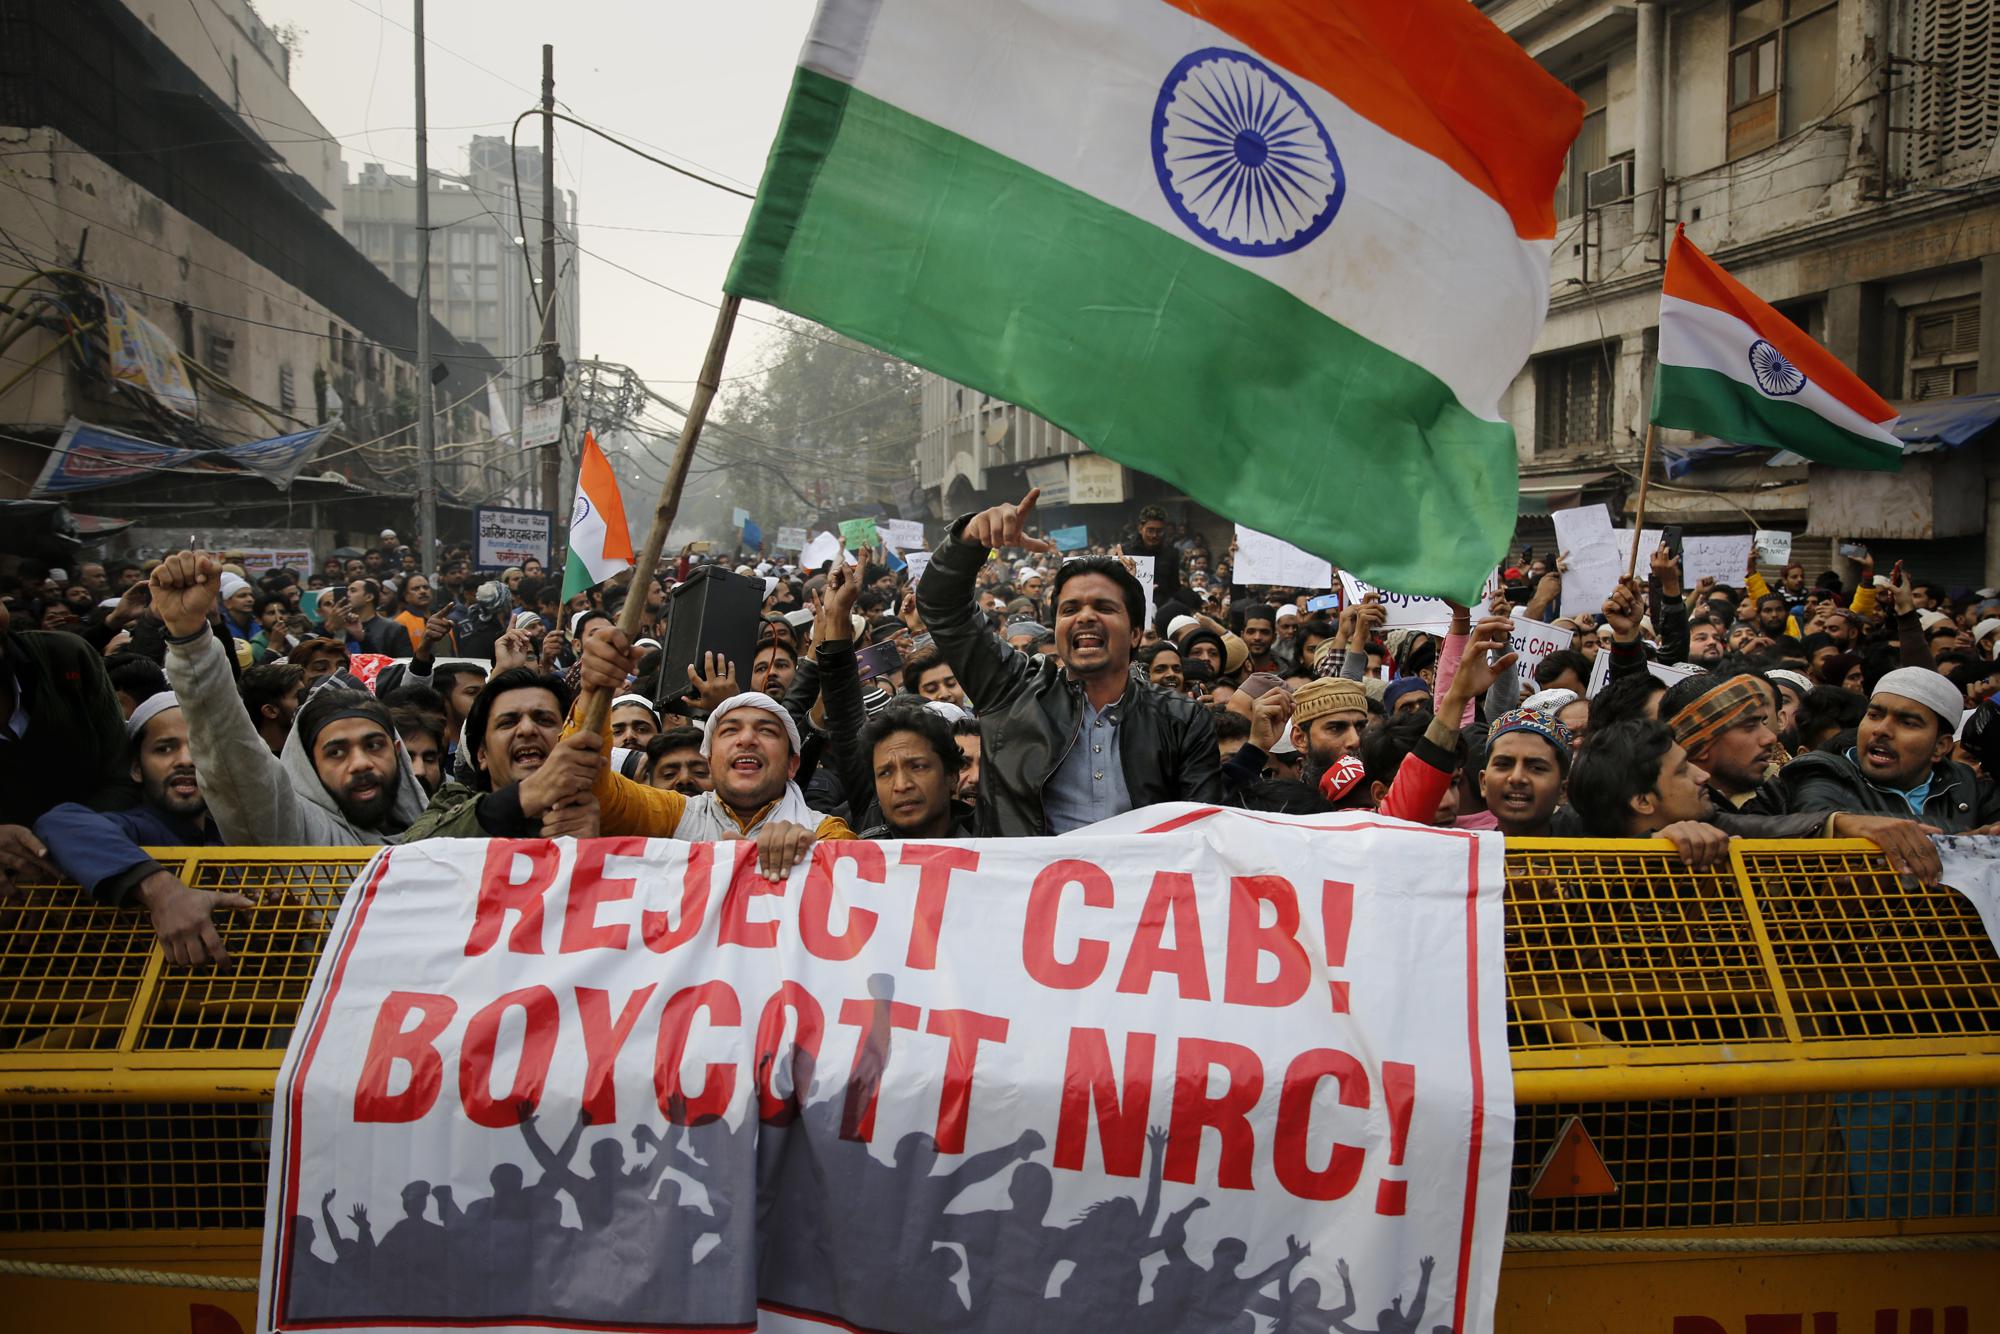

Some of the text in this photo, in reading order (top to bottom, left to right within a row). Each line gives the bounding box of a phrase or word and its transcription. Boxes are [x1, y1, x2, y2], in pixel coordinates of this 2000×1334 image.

[1377, 588, 1442, 608] Boyc
[464, 837, 1354, 1015] REJECT CAB!
[354, 980, 1415, 1216] BOYCOTT NRC!
